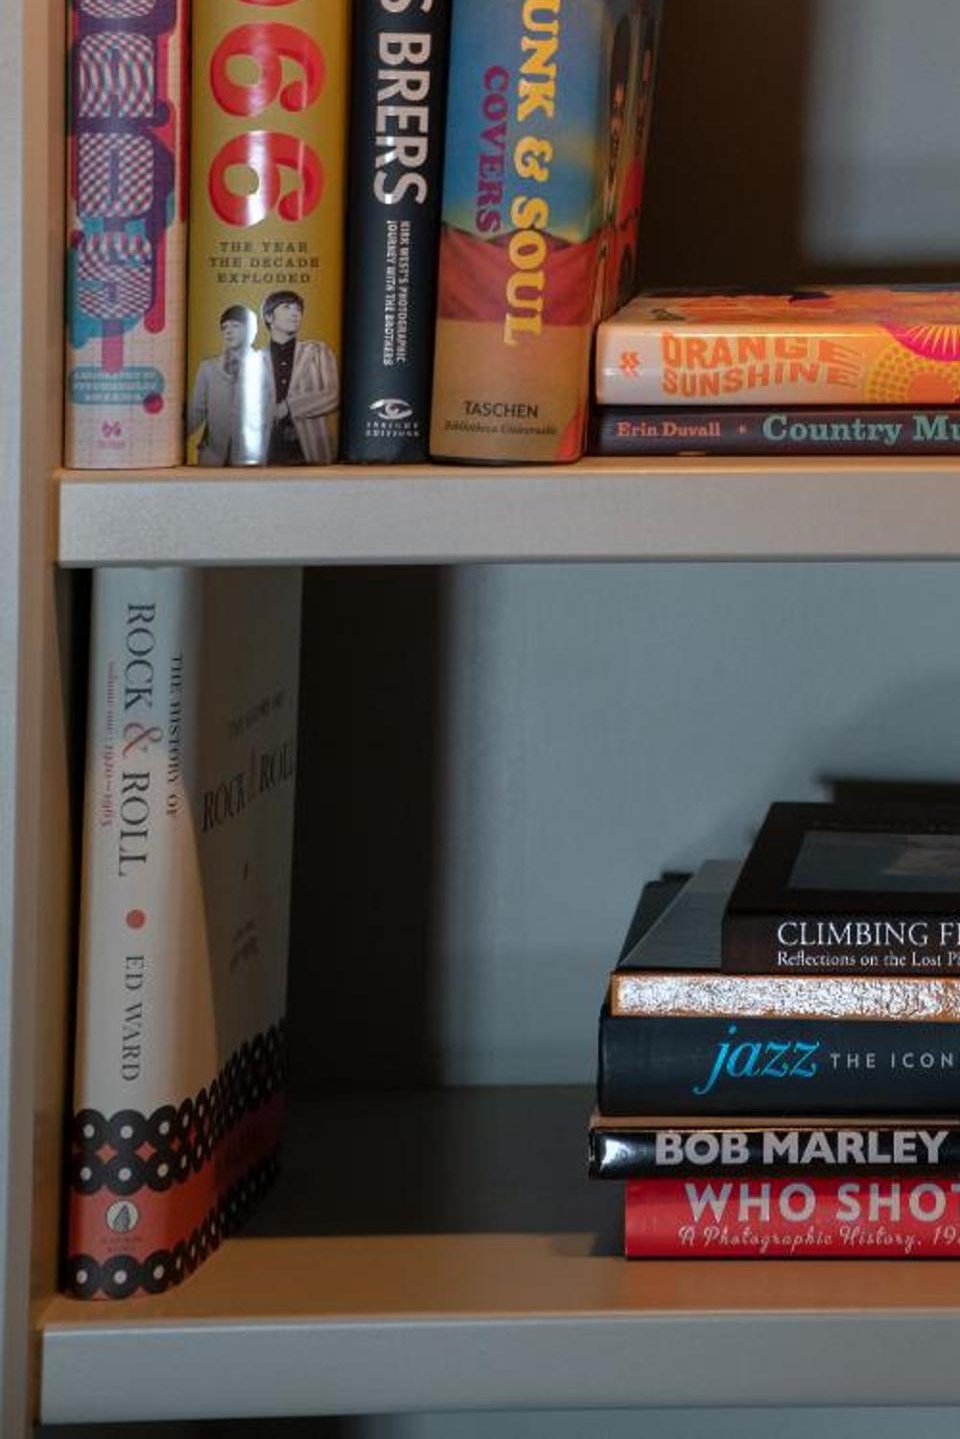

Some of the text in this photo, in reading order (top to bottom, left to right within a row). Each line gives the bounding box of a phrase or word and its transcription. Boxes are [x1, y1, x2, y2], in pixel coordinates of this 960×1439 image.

[373, 32, 432, 205] BRERS
[475, 65, 509, 234] COVERS
[512, 135, 553, 183] &
[219, 241, 309, 253] THE YEAR
[386, 219, 398, 264] JOURNEY
[399, 219, 410, 244] KIRK
[208, 256, 320, 268] THE DECADE
[217, 272, 311, 284] EXPLODED
[385, 265, 396, 291] WITH
[503, 194, 550, 348] SOUL
[384, 292, 396, 312] THE
[396, 285, 408, 364] PHOTOGRAPHIC
[661, 330, 862, 369] ORANGE
[661, 361, 859, 398] SUNSHINE
[463, 400, 538, 419] TASCHEN
[616, 421, 657, 437] Erin
[662, 421, 721, 438] Duvall
[762, 414, 903, 446] Country
[117, 602, 163, 878] ROCK & ROLL
[166, 655, 184, 819] THE HISTORY OF
[777, 921, 930, 947] CLIMBING
[777, 950, 857, 968] Reflections
[860, 954, 879, 967] on
[883, 951, 907, 968] the
[912, 952, 942, 968] Lost
[121, 953, 145, 1083] ED WARD
[692, 1024, 821, 1096] jazz
[830, 1052, 878, 1069] THE
[655, 1130, 950, 1165] BOB MARLEY
[684, 1182, 817, 1223] WHO
[677, 1225, 696, 1247] A
[703, 1224, 833, 1254] Photographic
